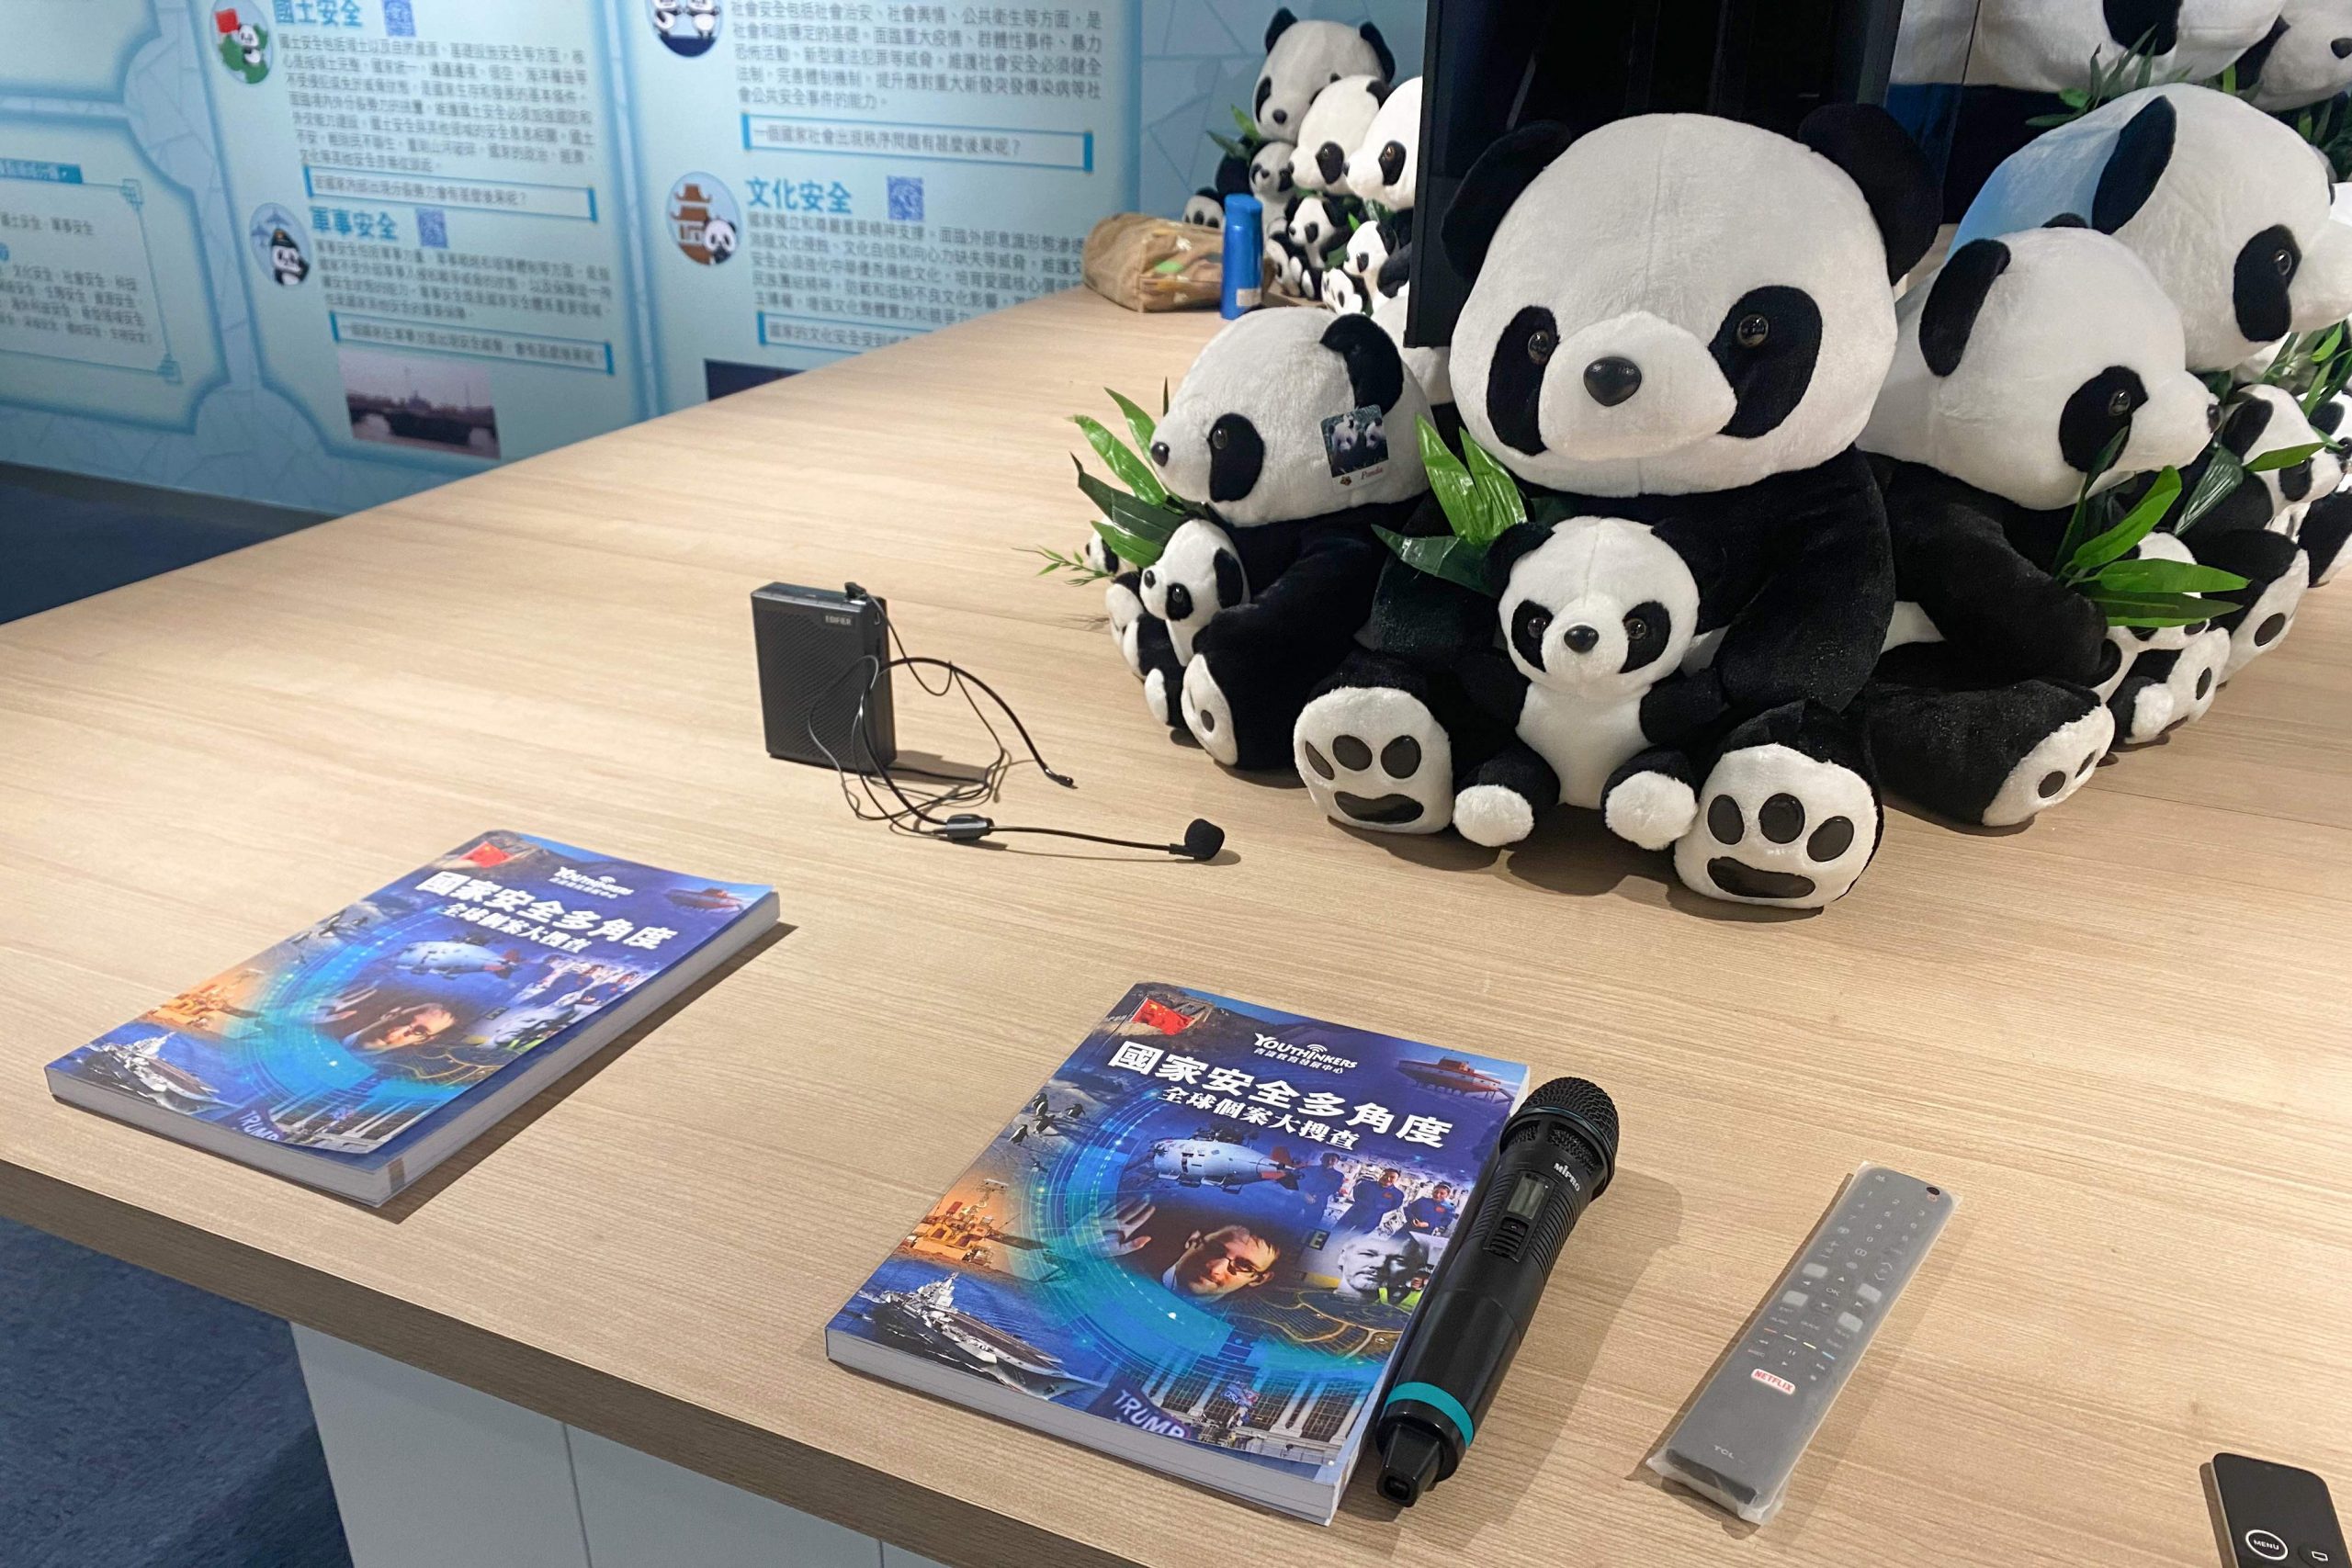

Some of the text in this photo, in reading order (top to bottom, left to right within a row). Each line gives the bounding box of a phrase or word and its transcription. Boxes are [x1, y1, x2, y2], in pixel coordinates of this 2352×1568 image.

[273, 0, 362, 27] 國土安全
[746, 175, 853, 214] 文化安全
[310, 207, 399, 240] 軍事安全
[825, 615, 852, 626] EDIFIER
[414, 871, 678, 950] 國家安全多角度
[1254, 1032, 1358, 1068] YOUTHINKERS
[1107, 1041, 1453, 1149] 國家安全多角度
[1158, 1086, 1361, 1152] 全球個案大搜查
[1826, 1287, 1840, 1298] OK
[1754, 1370, 1793, 1393] NETFLIX
[1114, 1389, 1186, 1438] TRUMP
[1713, 1445, 1735, 1459] TCL
[2254, 1539, 2279, 1551] MENU
